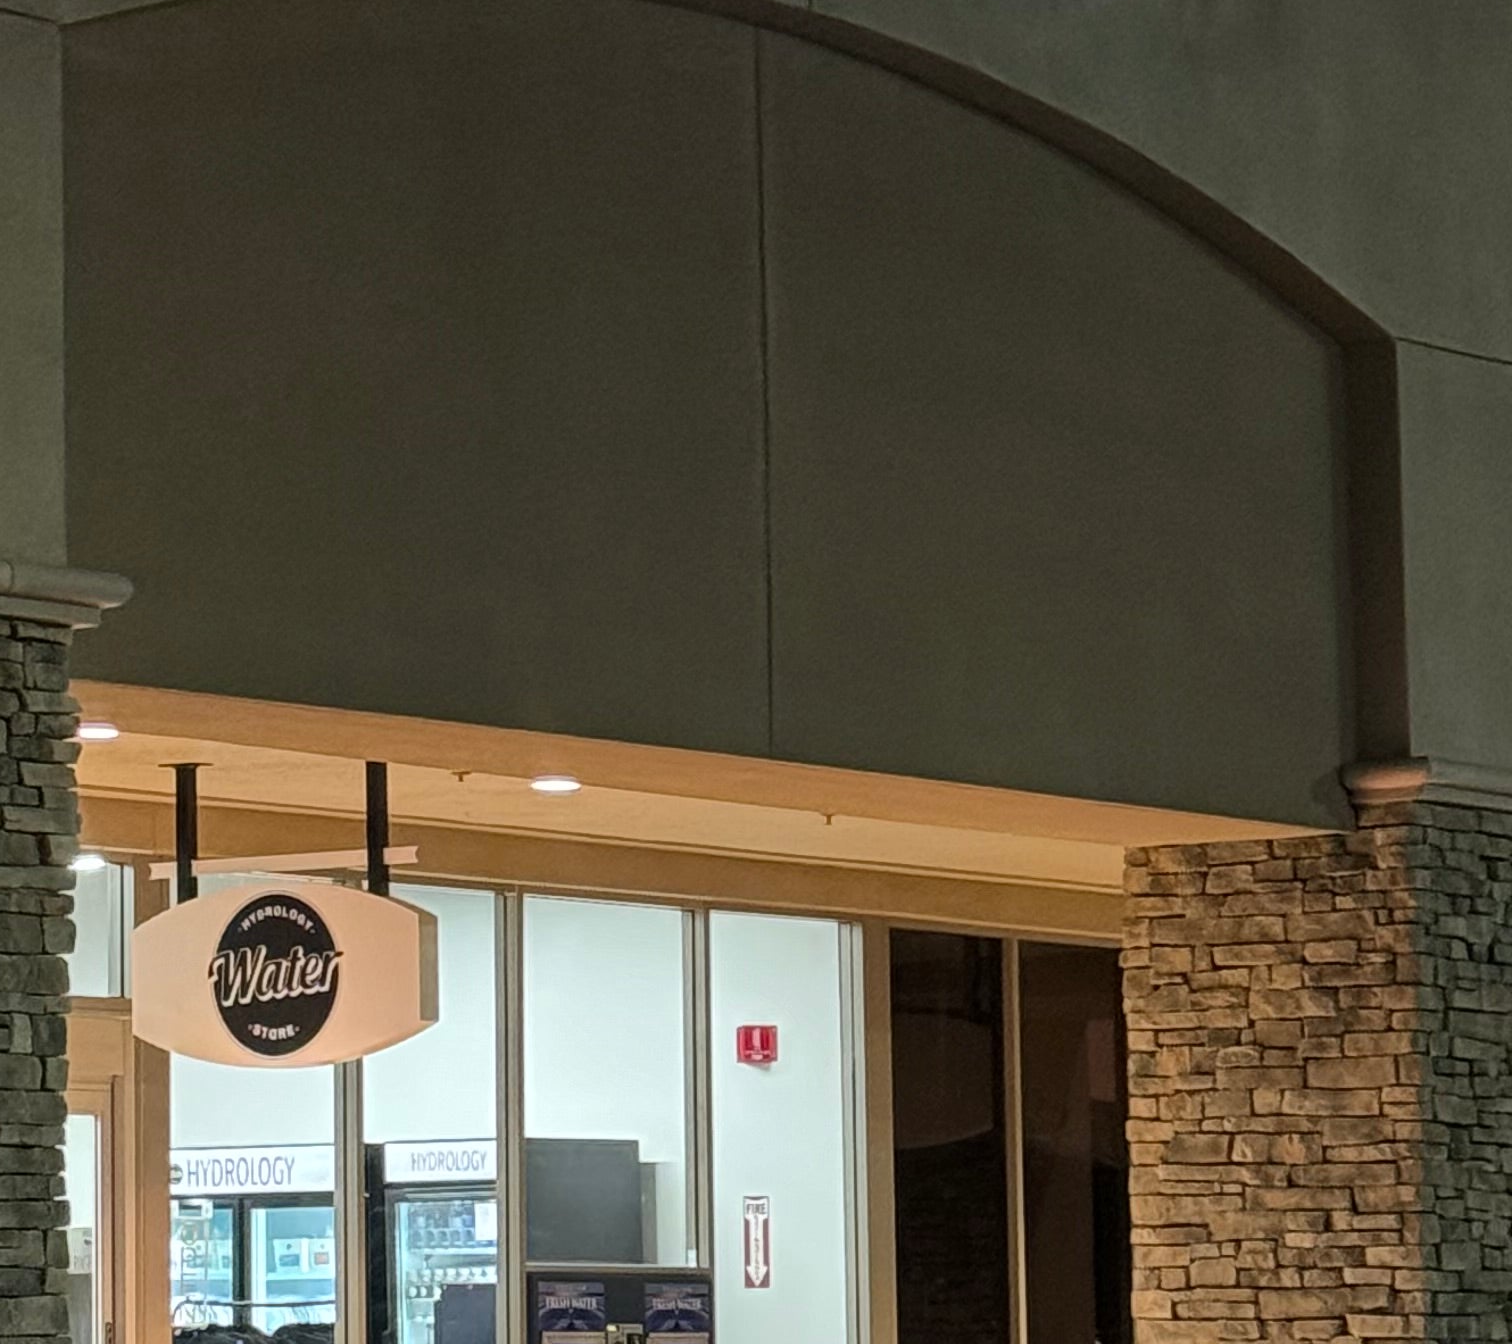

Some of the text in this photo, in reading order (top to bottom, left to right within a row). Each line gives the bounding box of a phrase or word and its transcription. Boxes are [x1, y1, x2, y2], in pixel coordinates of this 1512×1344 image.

[241, 905, 314, 931] HYDROLOGY
[208, 944, 344, 1007] Water
[252, 1023, 295, 1041] STORE
[187, 1156, 295, 1187] HYDROLOGY
[411, 1150, 487, 1172] HYDROLOGY
